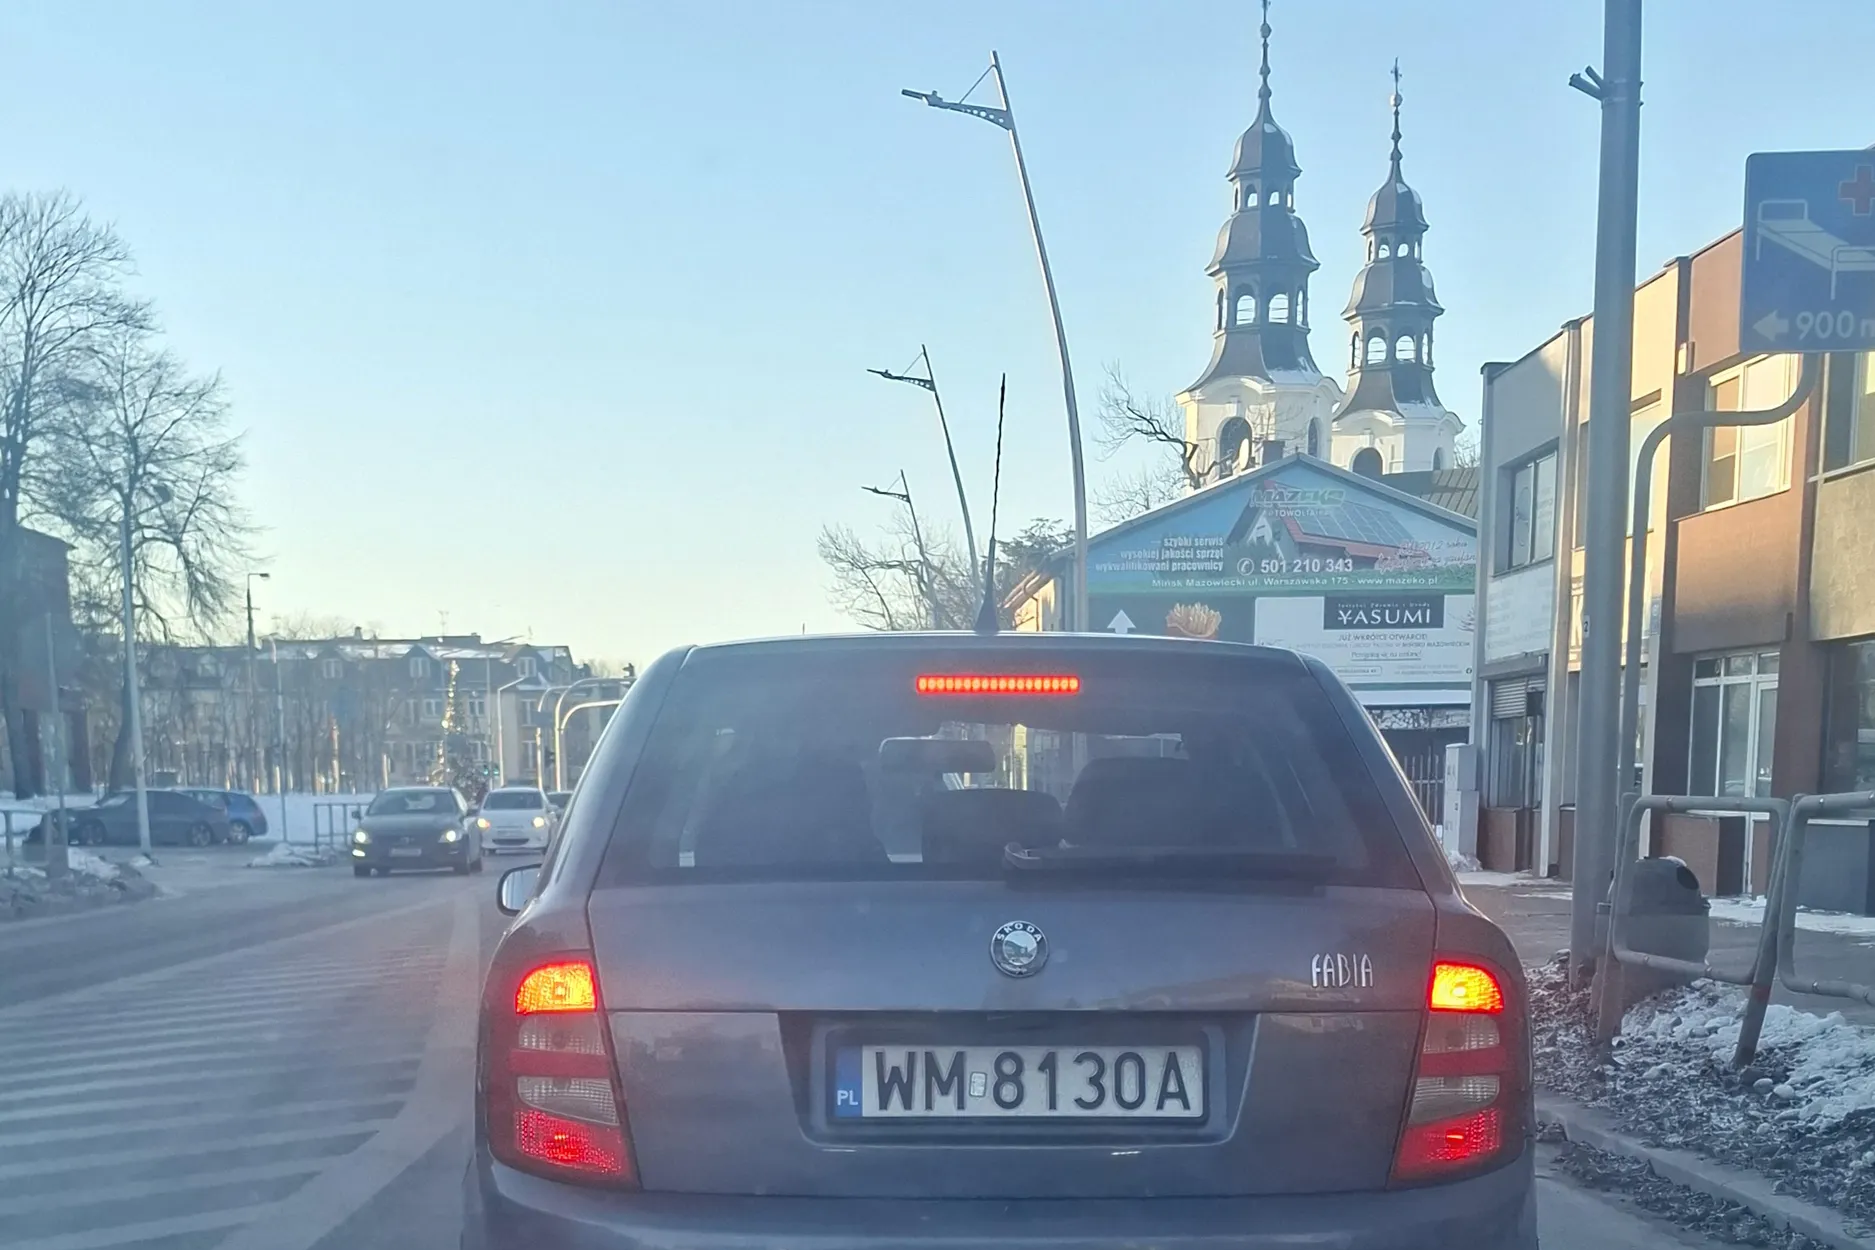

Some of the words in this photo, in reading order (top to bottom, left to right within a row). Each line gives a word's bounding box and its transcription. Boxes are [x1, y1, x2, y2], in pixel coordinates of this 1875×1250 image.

[1796, 310, 1854, 341] 900
[1250, 488, 1345, 508] MAZEKO
[1164, 537, 1191, 547] szybki
[1194, 537, 1224, 546] serwis
[1120, 549, 1159, 560] wysokiej
[1161, 548, 1193, 560] jakości
[1171, 560, 1224, 572] pracownicy
[1260, 559, 1287, 573] 501
[1293, 559, 1320, 573] 210
[1325, 558, 1353, 572] 343
[1186, 578, 1245, 587] Mazowiecki
[1263, 577, 1327, 586] Warszawska
[1331, 577, 1349, 585] 175
[1337, 608, 1431, 625] YASUMI
[1311, 952, 1374, 987] FABIA
[875, 1050, 966, 1111] WM
[992, 1050, 1191, 1111] 8130A
[837, 1090, 858, 1105] PL
